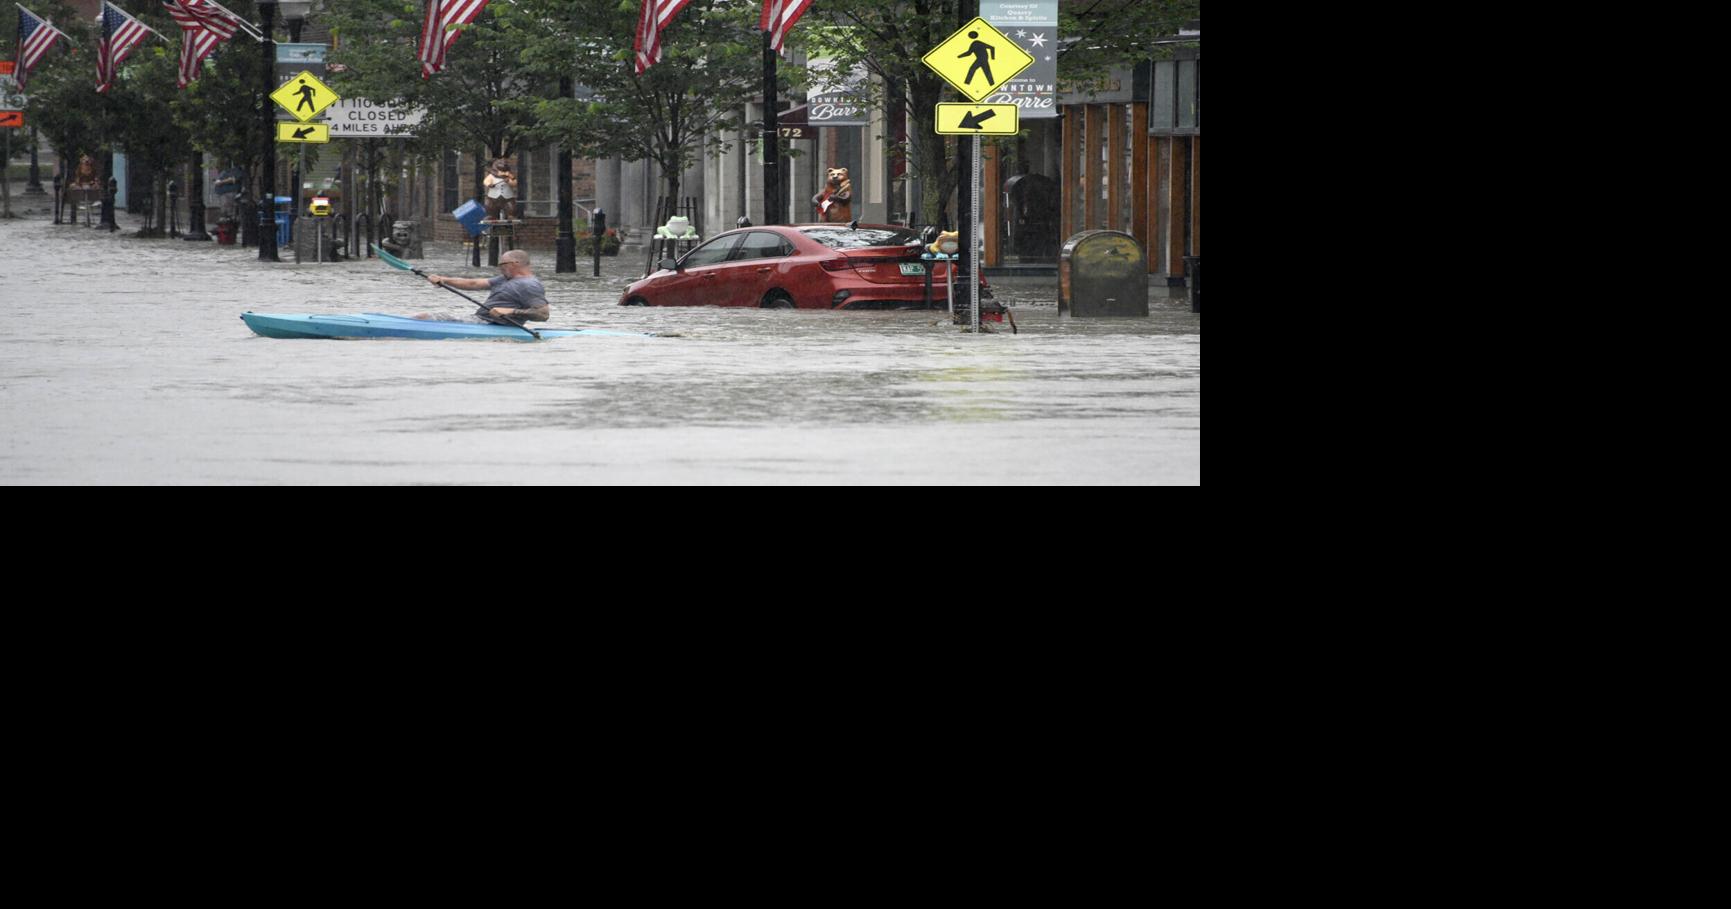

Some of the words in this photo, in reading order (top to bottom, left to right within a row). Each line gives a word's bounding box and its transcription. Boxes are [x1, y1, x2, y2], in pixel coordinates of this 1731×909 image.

[1000, 84, 1053, 92] WNTOWN
[348, 111, 406, 121] CLOSED
[331, 124, 339, 132] 4
[342, 124, 378, 132] MILES
